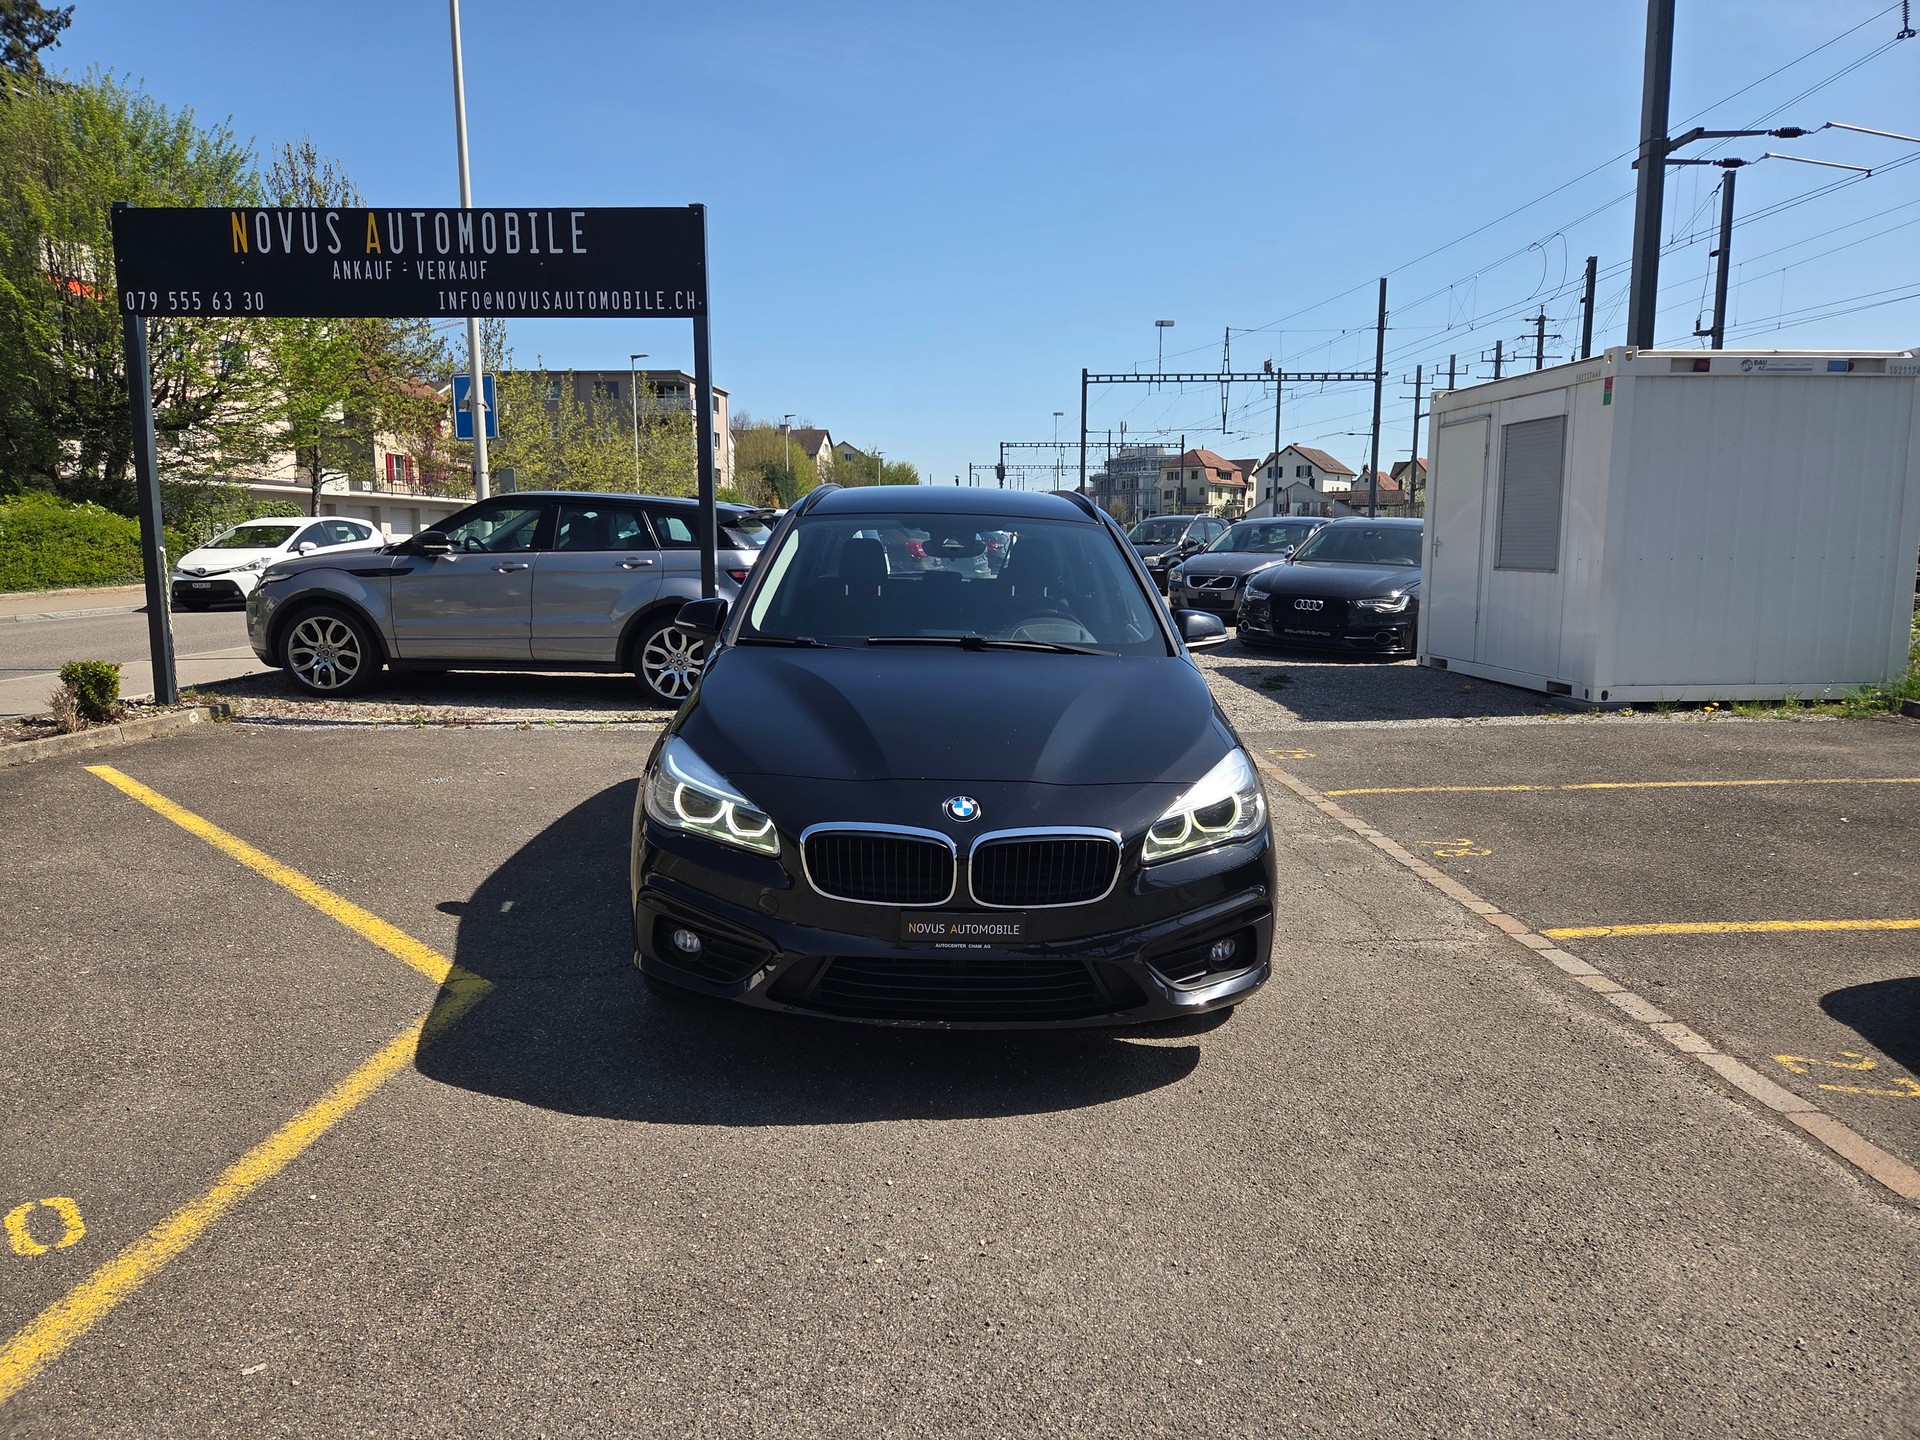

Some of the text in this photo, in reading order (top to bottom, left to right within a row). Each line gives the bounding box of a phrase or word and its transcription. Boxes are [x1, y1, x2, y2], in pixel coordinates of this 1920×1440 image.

[231, 211, 588, 254] NOVUS AUTOMOBILE
[333, 260, 393, 280] ANKAUF
[416, 260, 488, 280] VERKAUF
[126, 291, 264, 311] 079 555 63 30
[439, 290, 696, 310] INFO@NOVUSAUTOMOBILE.CH
[908, 923, 1020, 935] NOVUS AUTOMOBILE
